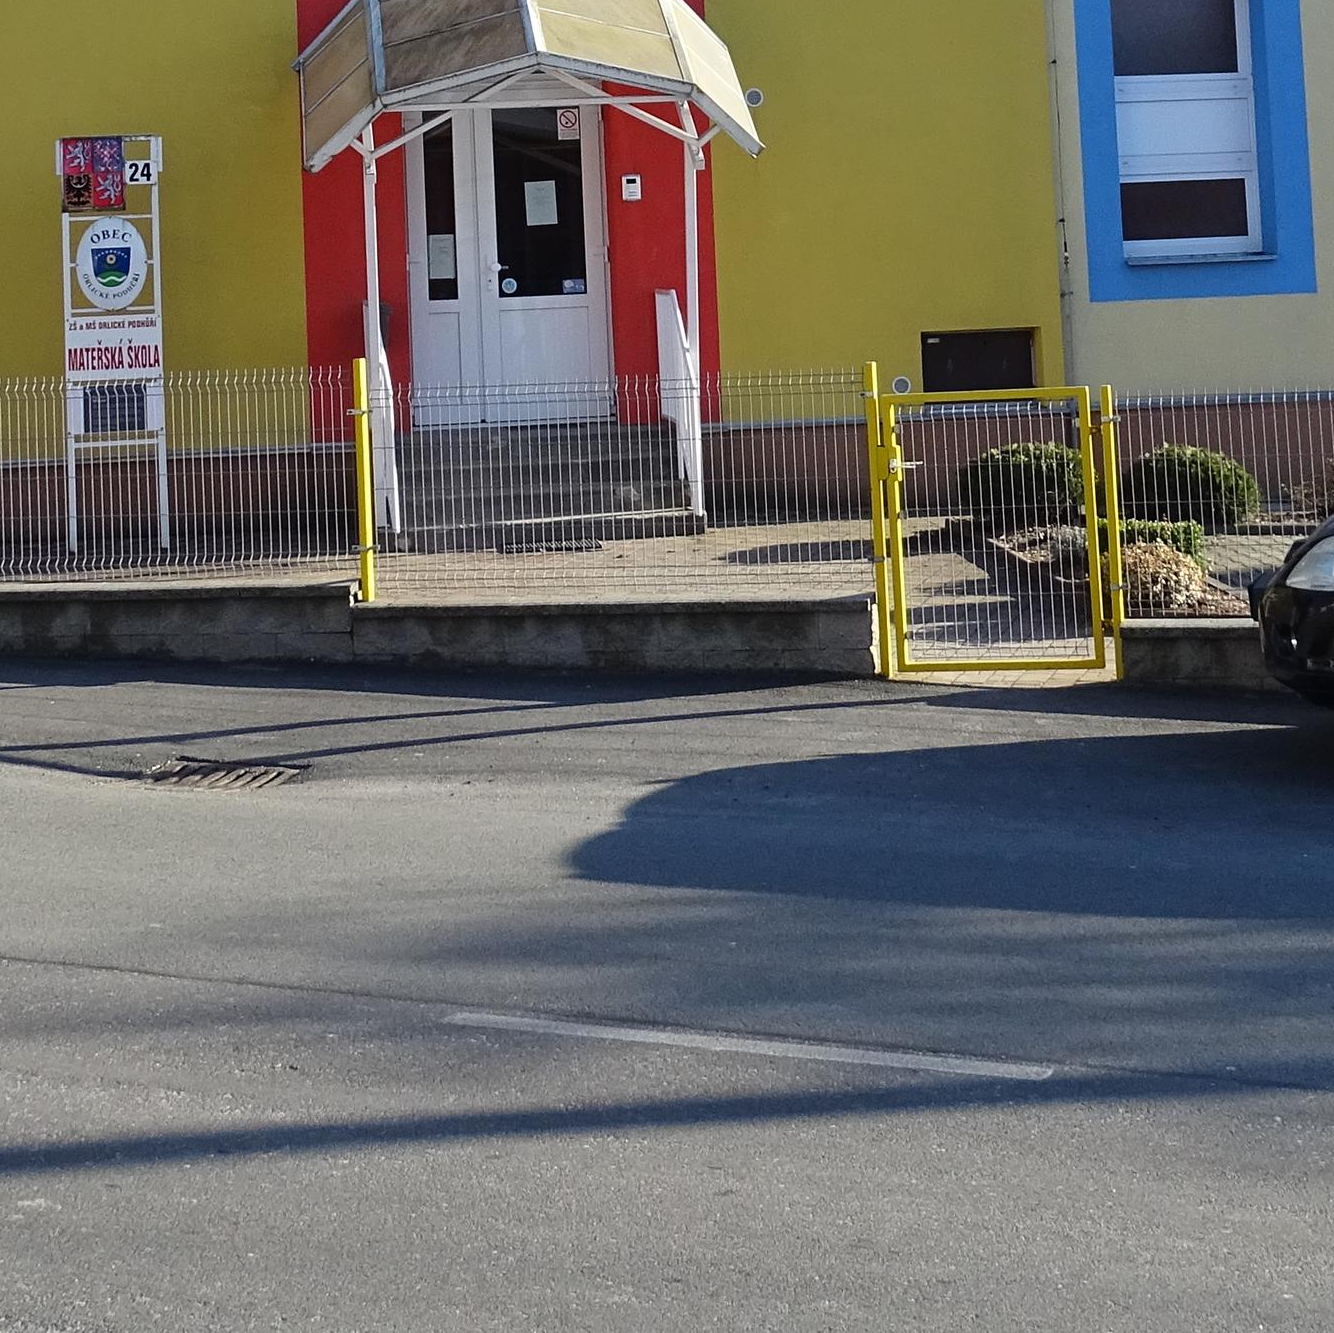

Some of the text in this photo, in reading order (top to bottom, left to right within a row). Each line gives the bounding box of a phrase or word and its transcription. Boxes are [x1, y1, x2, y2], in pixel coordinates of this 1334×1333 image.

[129, 163, 152, 182] 24
[90, 229, 132, 244] OBEC
[85, 319, 97, 330] MŠ
[68, 338, 161, 371] MATEŘSKÁ ŠKOLA
